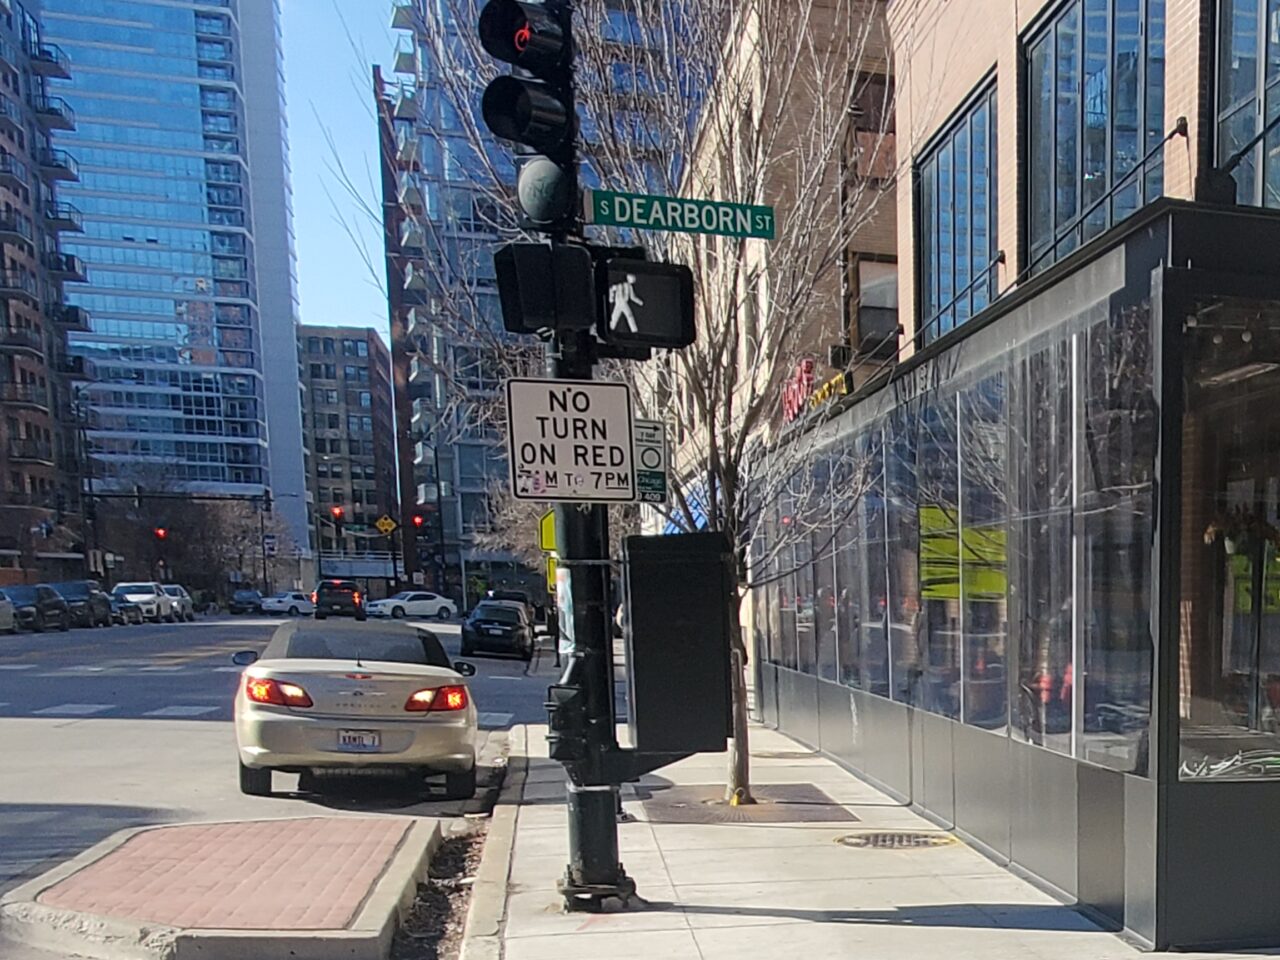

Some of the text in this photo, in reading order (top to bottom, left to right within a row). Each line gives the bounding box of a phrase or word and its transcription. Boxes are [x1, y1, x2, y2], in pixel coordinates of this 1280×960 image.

[600, 196, 772, 234] S DEARBORN ST
[549, 389, 590, 413] NO
[536, 416, 607, 441] TURN
[521, 442, 625, 467] ON RED
[590, 471, 630, 490] 7PM
